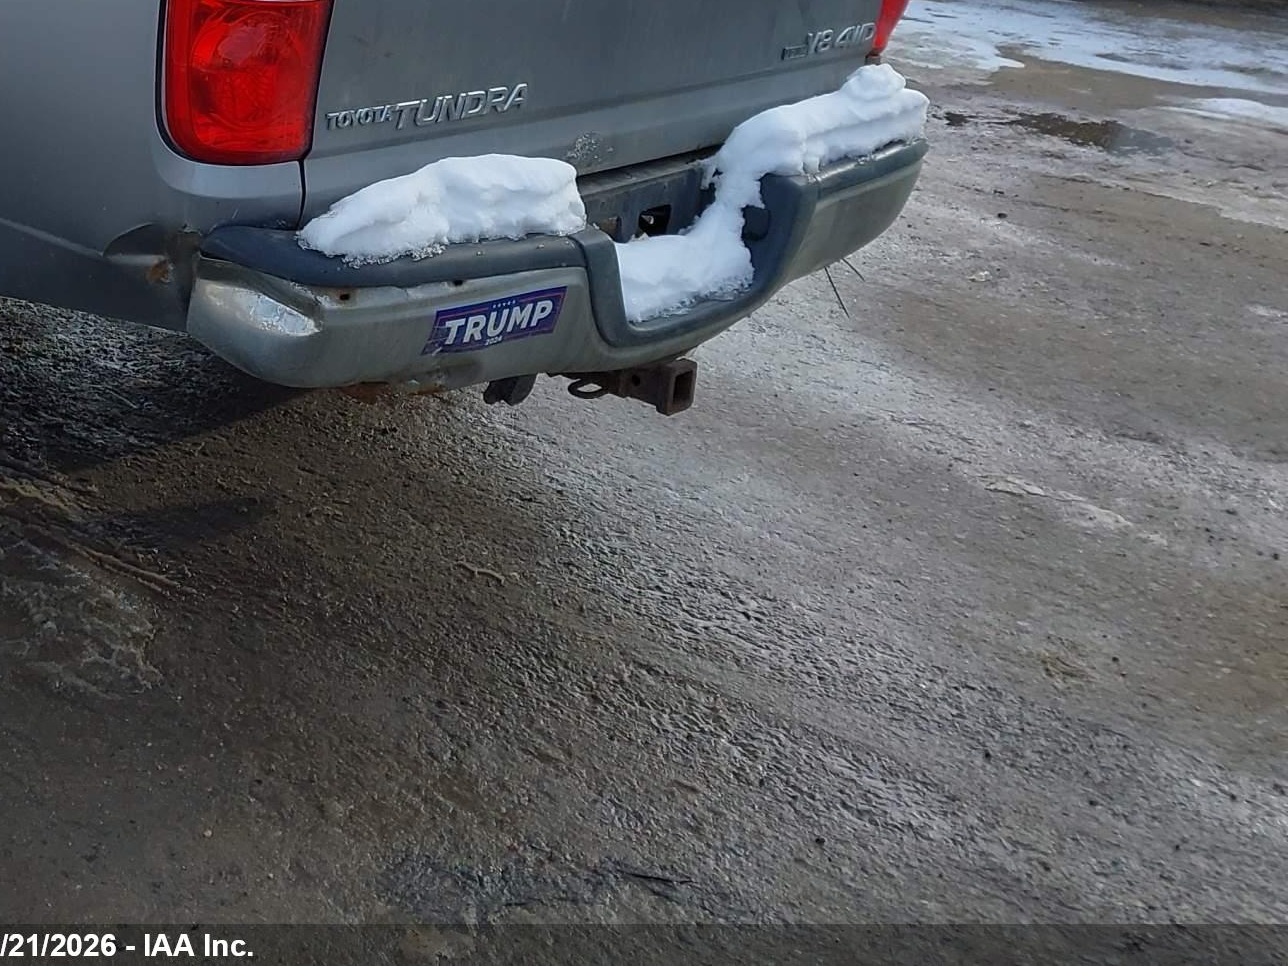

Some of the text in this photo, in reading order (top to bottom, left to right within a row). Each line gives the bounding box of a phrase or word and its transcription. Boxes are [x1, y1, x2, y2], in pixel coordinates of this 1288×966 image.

[808, 29, 833, 54] V8
[326, 83, 528, 130] TOYOTA TUNDRA
[445, 300, 553, 345] TRUMP
